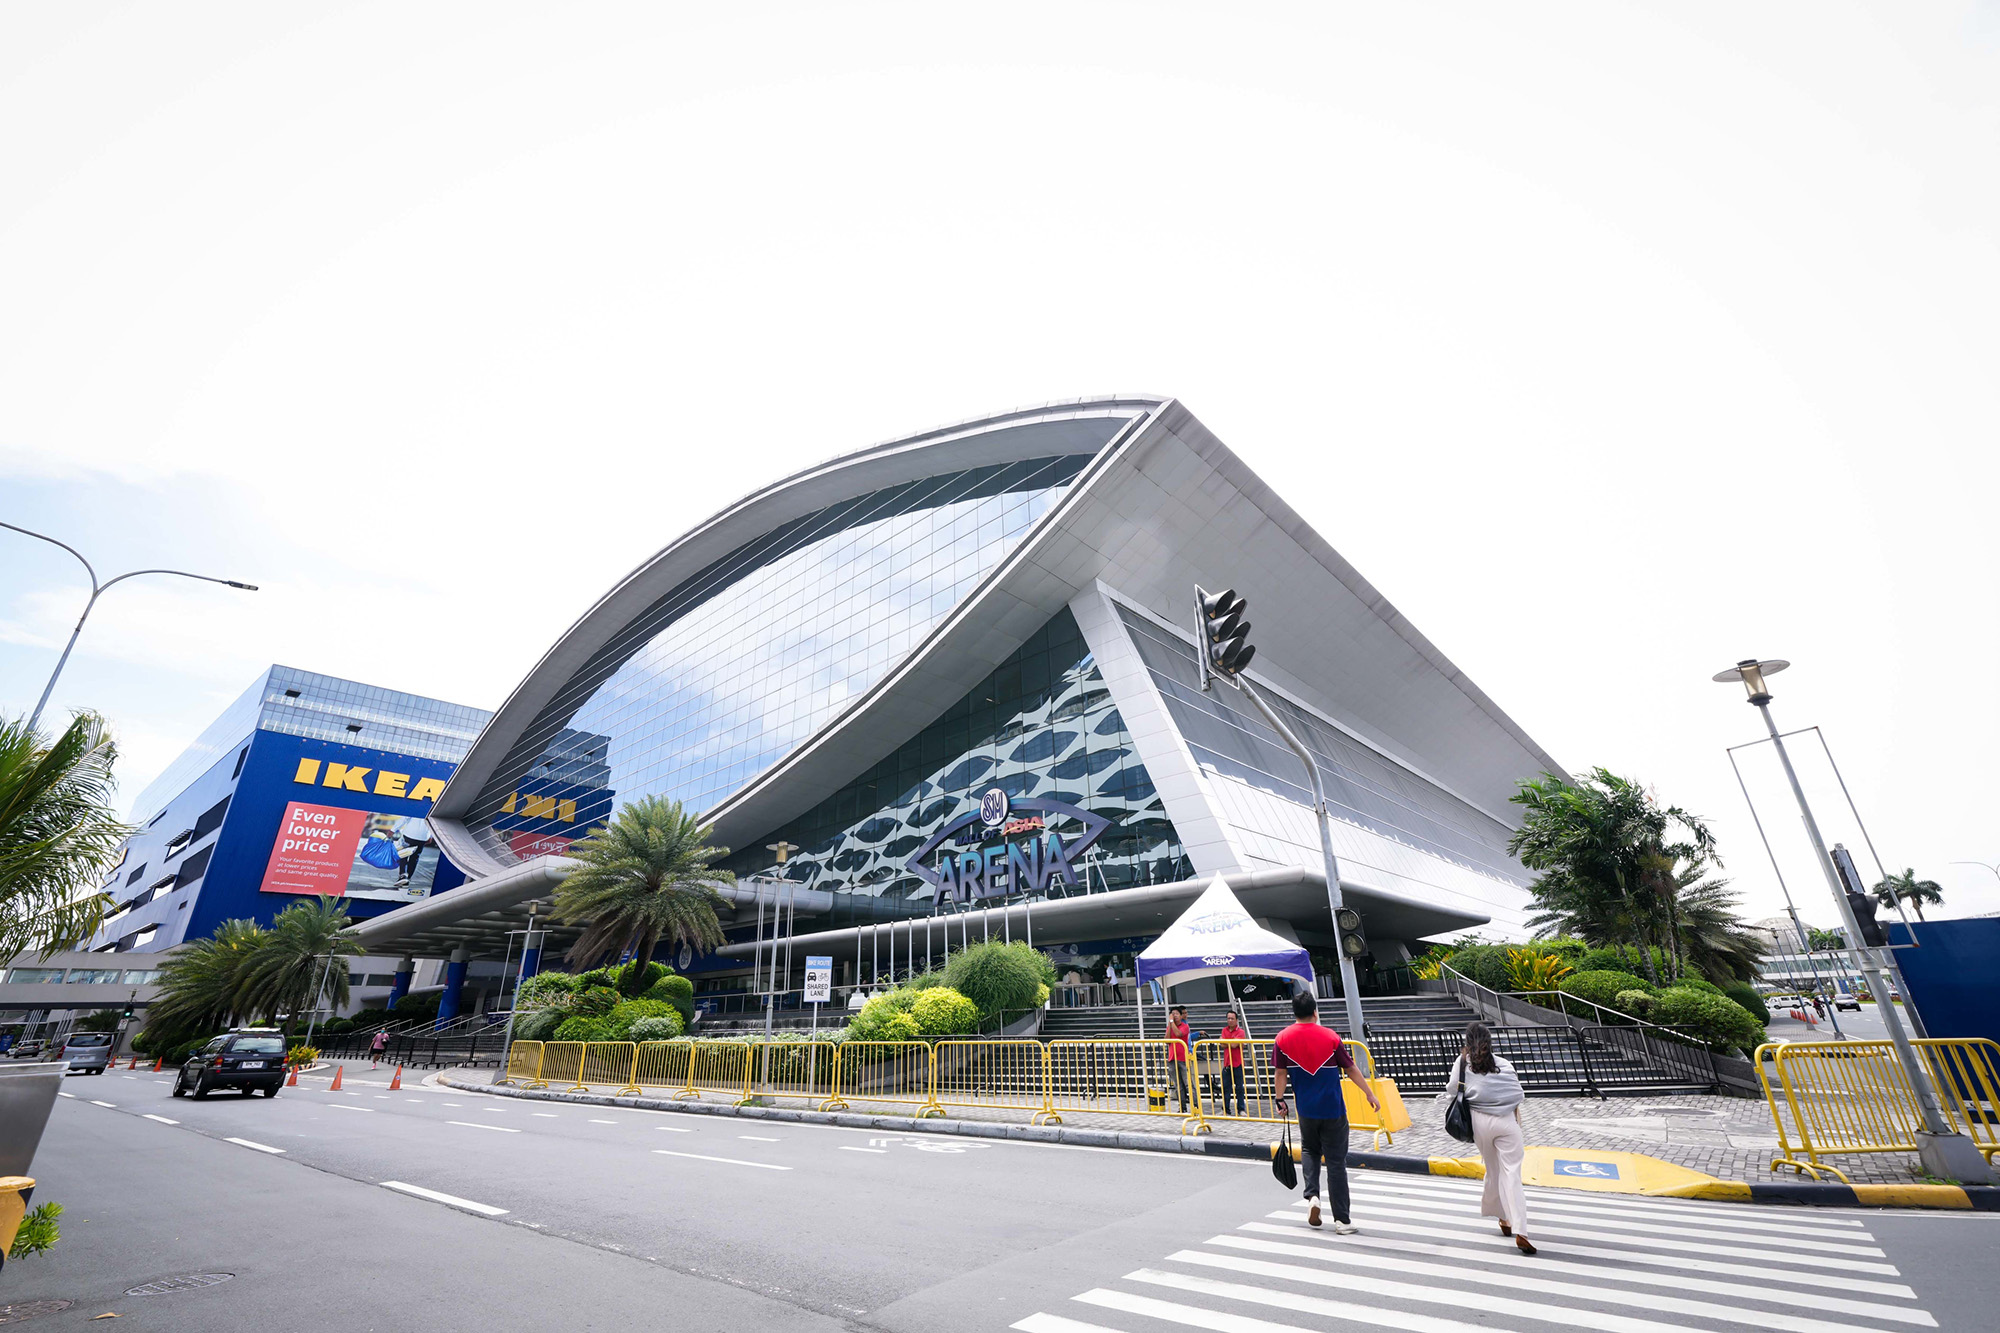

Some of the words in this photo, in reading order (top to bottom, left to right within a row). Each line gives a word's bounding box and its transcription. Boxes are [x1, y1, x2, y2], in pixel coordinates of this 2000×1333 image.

[294, 757, 446, 803] IKEA
[983, 790, 1004, 823] SM
[292, 808, 336, 825] Even
[287, 822, 340, 840] lower
[955, 831, 982, 846] MALL
[982, 828, 1001, 841] OF
[1002, 816, 1046, 837] ASIA
[281, 838, 330, 854] price
[932, 833, 1080, 907] ARENA
[1191, 919, 1242, 935] ARENA
[1206, 957, 1231, 966] ARENA
